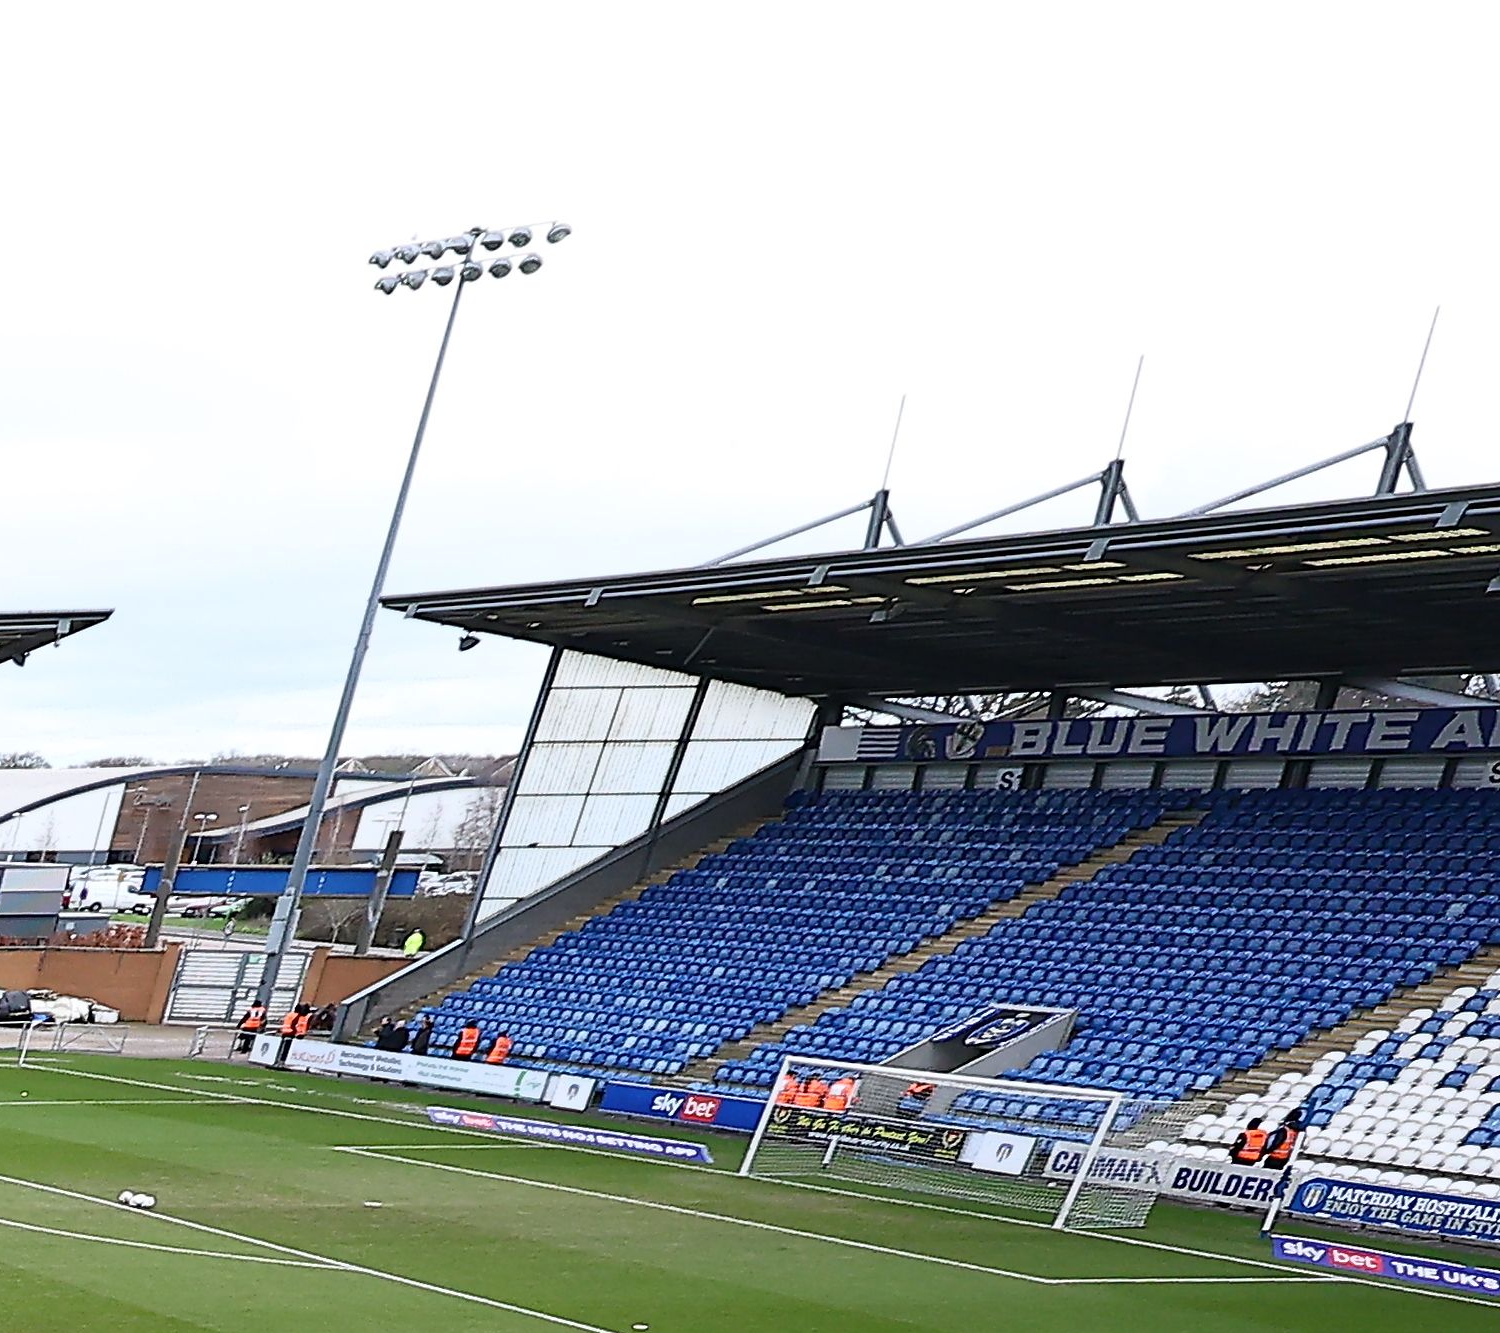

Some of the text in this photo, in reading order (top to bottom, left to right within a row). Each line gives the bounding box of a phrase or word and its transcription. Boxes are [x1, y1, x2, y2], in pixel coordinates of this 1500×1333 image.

[1009, 719, 1176, 757] BLUE
[1193, 710, 1424, 755] WHITE
[651, 1092, 719, 1119] sky bet
[595, 1132, 664, 1153] BETTING
[1327, 1185, 1412, 1211] MATCHDAY
[1321, 1200, 1466, 1231] ENJOY THE GAME IN
[1282, 1241, 1500, 1291] sky bet THE UK'S
